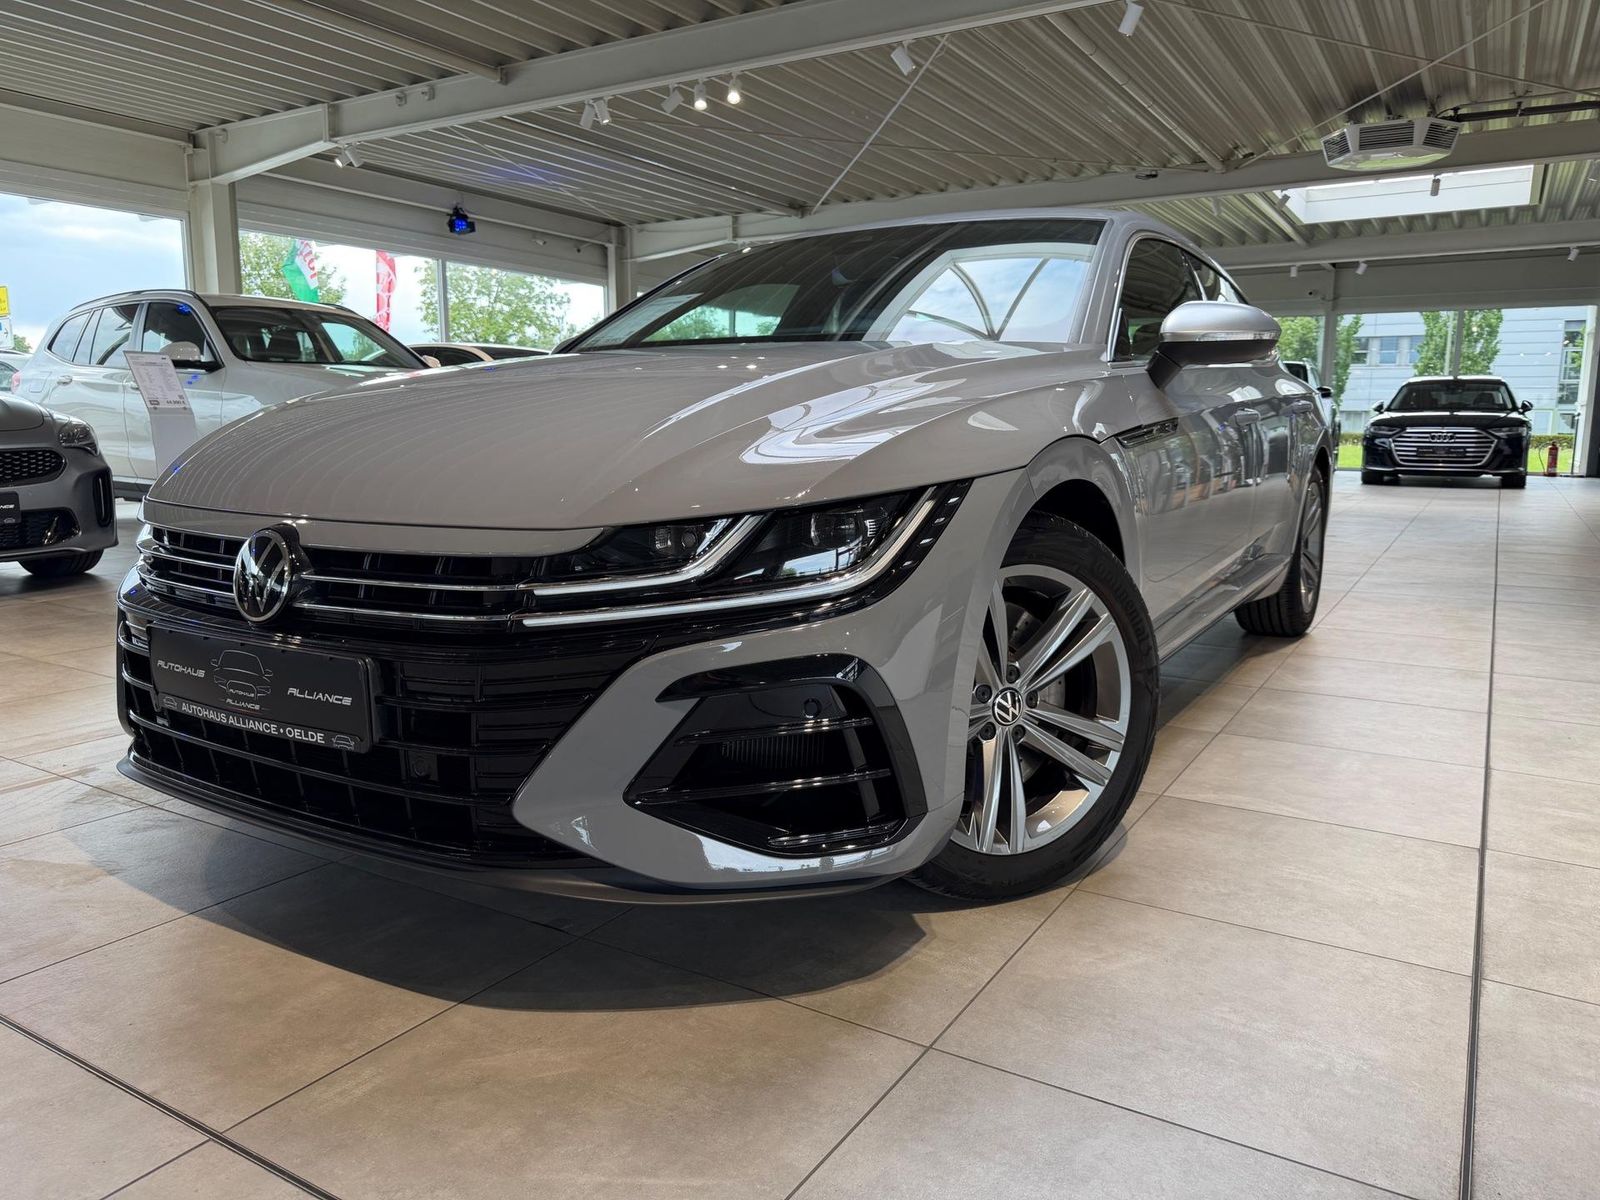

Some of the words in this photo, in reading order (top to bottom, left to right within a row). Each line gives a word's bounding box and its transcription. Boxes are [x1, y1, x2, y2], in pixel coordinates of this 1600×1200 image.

[156, 659, 206, 678] AUTOHAUS
[287, 687, 353, 706] ALLIANCE
[228, 688, 255, 698] AUTOHAUS
[225, 698, 261, 710] ALLIANCE
[181, 702, 227, 723] AUTOHAUS
[228, 715, 278, 734] ALLIANCE
[285, 727, 325, 744] OELDE
